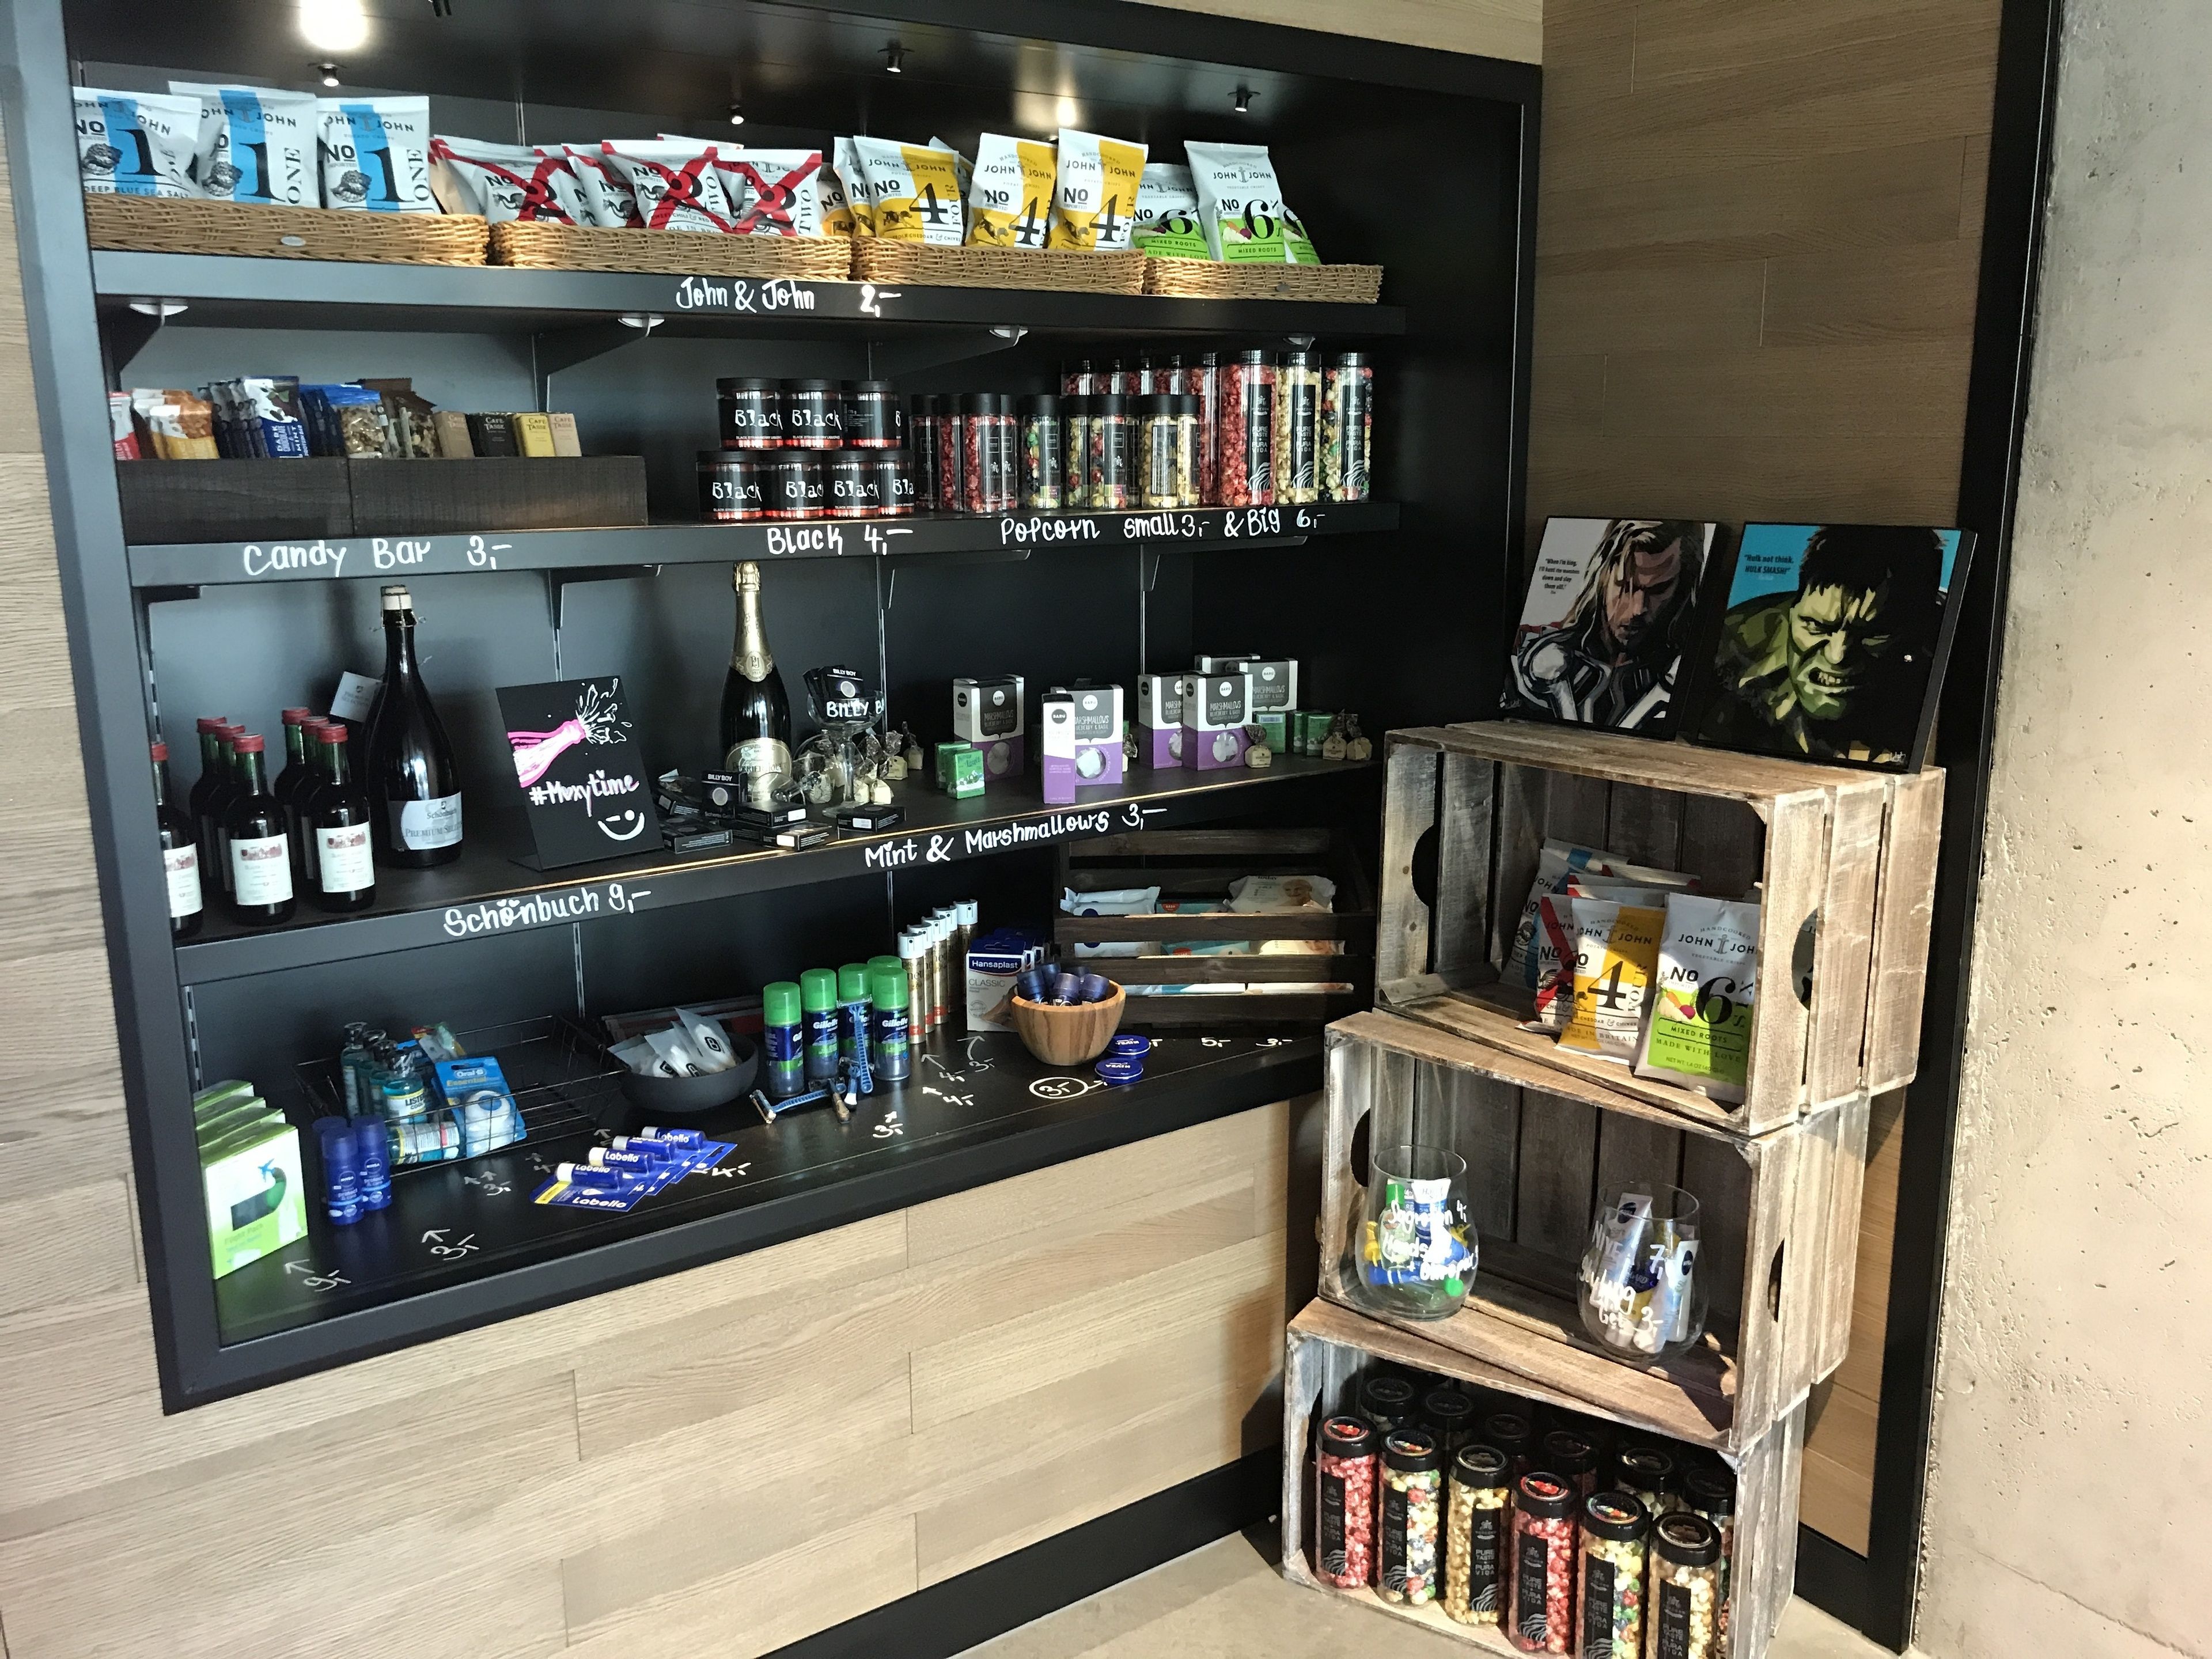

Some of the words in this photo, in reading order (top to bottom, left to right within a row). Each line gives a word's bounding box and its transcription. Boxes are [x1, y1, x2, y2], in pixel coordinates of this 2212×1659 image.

[256, 112, 297, 127] JOHN
[377, 121, 414, 132] JOHN
[327, 144, 356, 162] NO
[238, 142, 286, 202] 1
[363, 147, 415, 203] 1
[407, 149, 430, 201] ONE
[869, 158, 899, 168] JOHN
[915, 164, 946, 172] JOHN
[984, 165, 1015, 174] JOHN
[1029, 169, 1052, 180] JOHN
[1066, 160, 1096, 171] JOHN
[1109, 166, 1136, 178] JOHN
[285, 147, 302, 204] ONE
[874, 180, 900, 197] NO
[984, 189, 1009, 206] NO
[1064, 187, 1089, 204] NO
[821, 192, 843, 212] NO
[909, 183, 949, 225] 4
[1221, 198, 1239, 211] NO
[1008, 196, 1041, 246] 4
[1089, 194, 1121, 243] 4
[1134, 209, 1153, 222] NO
[1159, 209, 1193, 234] 6
[1244, 199, 1274, 240] 6
[676, 276, 728, 309] John
[734, 281, 757, 313] &
[762, 279, 815, 310] John
[735, 410, 783, 431] Black
[792, 410, 842, 431] Black
[712, 482, 763, 502] Black
[834, 480, 879, 500] Black
[1124, 512, 1179, 539] small
[1224, 514, 1245, 537] &
[1247, 507, 1281, 537] Big
[767, 524, 843, 556] Black
[243, 540, 347, 578] Candy
[372, 537, 432, 569] Bar
[865, 838, 918, 869] Mint
[926, 834, 955, 863] &
[965, 810, 1110, 854] Marshmallows
[444, 886, 600, 937] Schönbuch
[1576, 928, 1602, 937] JOHN
[1618, 933, 1652, 945] JOHN
[1700, 926, 1751, 940] HANDCOOKED
[1678, 934, 1714, 947] JOHN
[1730, 943, 1755, 955] JOH
[972, 960, 1018, 969] Hansaplast
[1691, 952, 1724, 963] VEGETABLE
[968, 978, 1006, 987] CLASSIC
[1588, 960, 1627, 1011] 4
[1669, 966, 1699, 986] NO
[1628, 963, 1647, 1012] FOUR
[1695, 976, 1736, 1025] 6
[1580, 1016, 1604, 1024] CHEDDAR
[1607, 1018, 1615, 1027] &
[1599, 1032, 1638, 1042] BRITAIN
[1671, 1025, 1696, 1036] MIXED
[1699, 1032, 1728, 1043] ROOTS
[1656, 1038, 1681, 1049] MADE
[1685, 1044, 1710, 1056] WITH
[1715, 1052, 1741, 1063] LOVE
[456, 1069, 484, 1077] Oral-B
[658, 1131, 690, 1144] Labello
[605, 1151, 639, 1163] Labello
[575, 1164, 611, 1173] Labello
[572, 1196, 628, 1209] Labello
